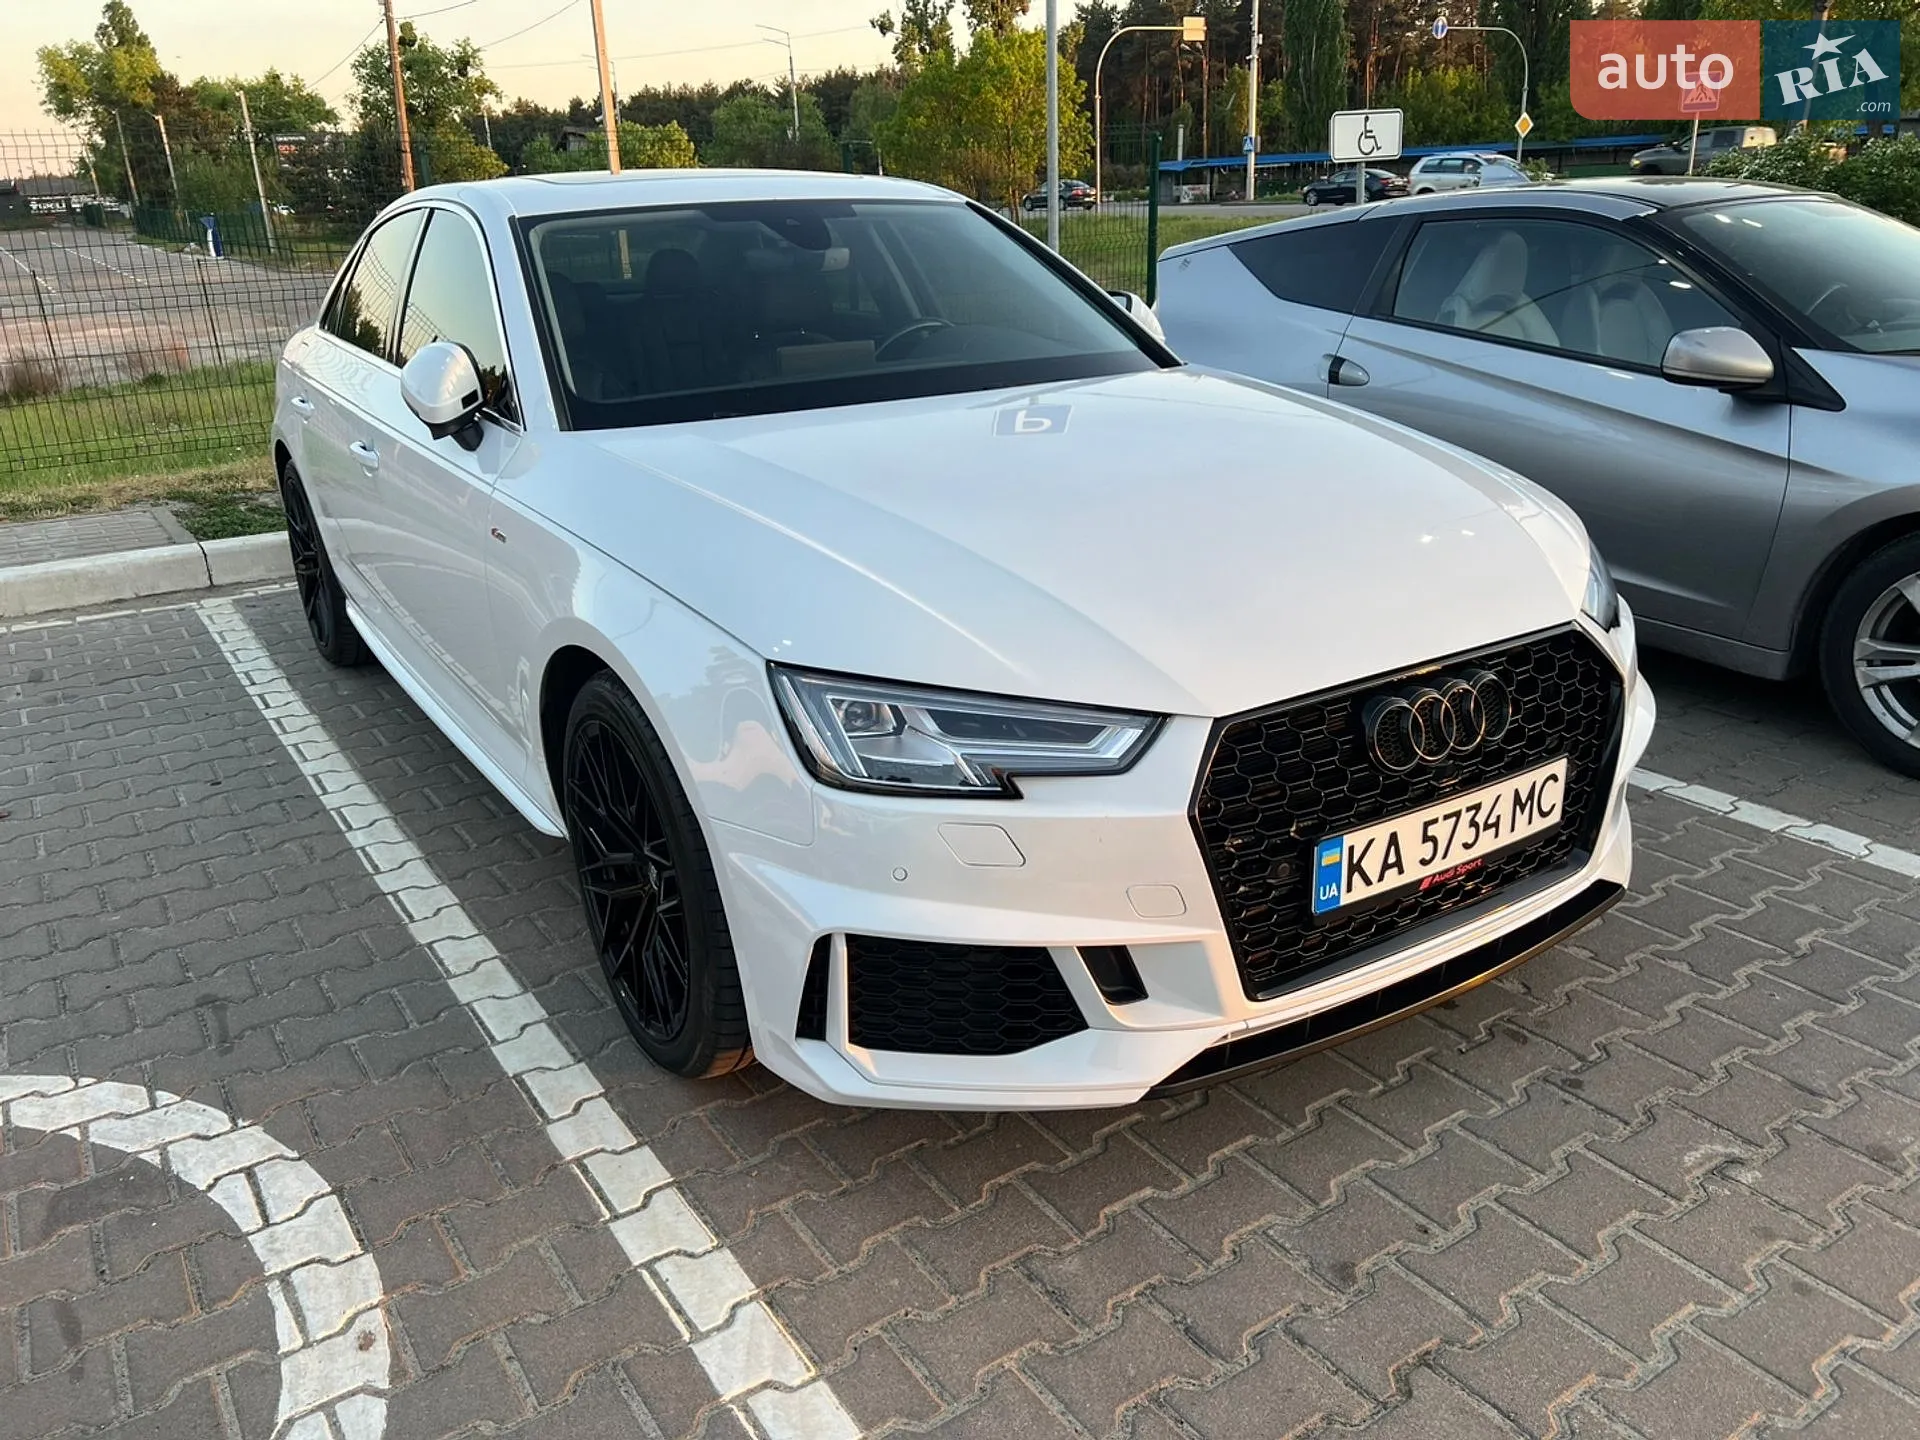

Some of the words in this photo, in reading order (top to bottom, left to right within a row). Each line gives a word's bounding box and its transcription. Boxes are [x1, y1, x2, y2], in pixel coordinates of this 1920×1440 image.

[1346, 831, 1405, 893] KA
[1419, 794, 1502, 867] 5734
[1510, 773, 1559, 833] MC
[1319, 883, 1339, 901] UA
